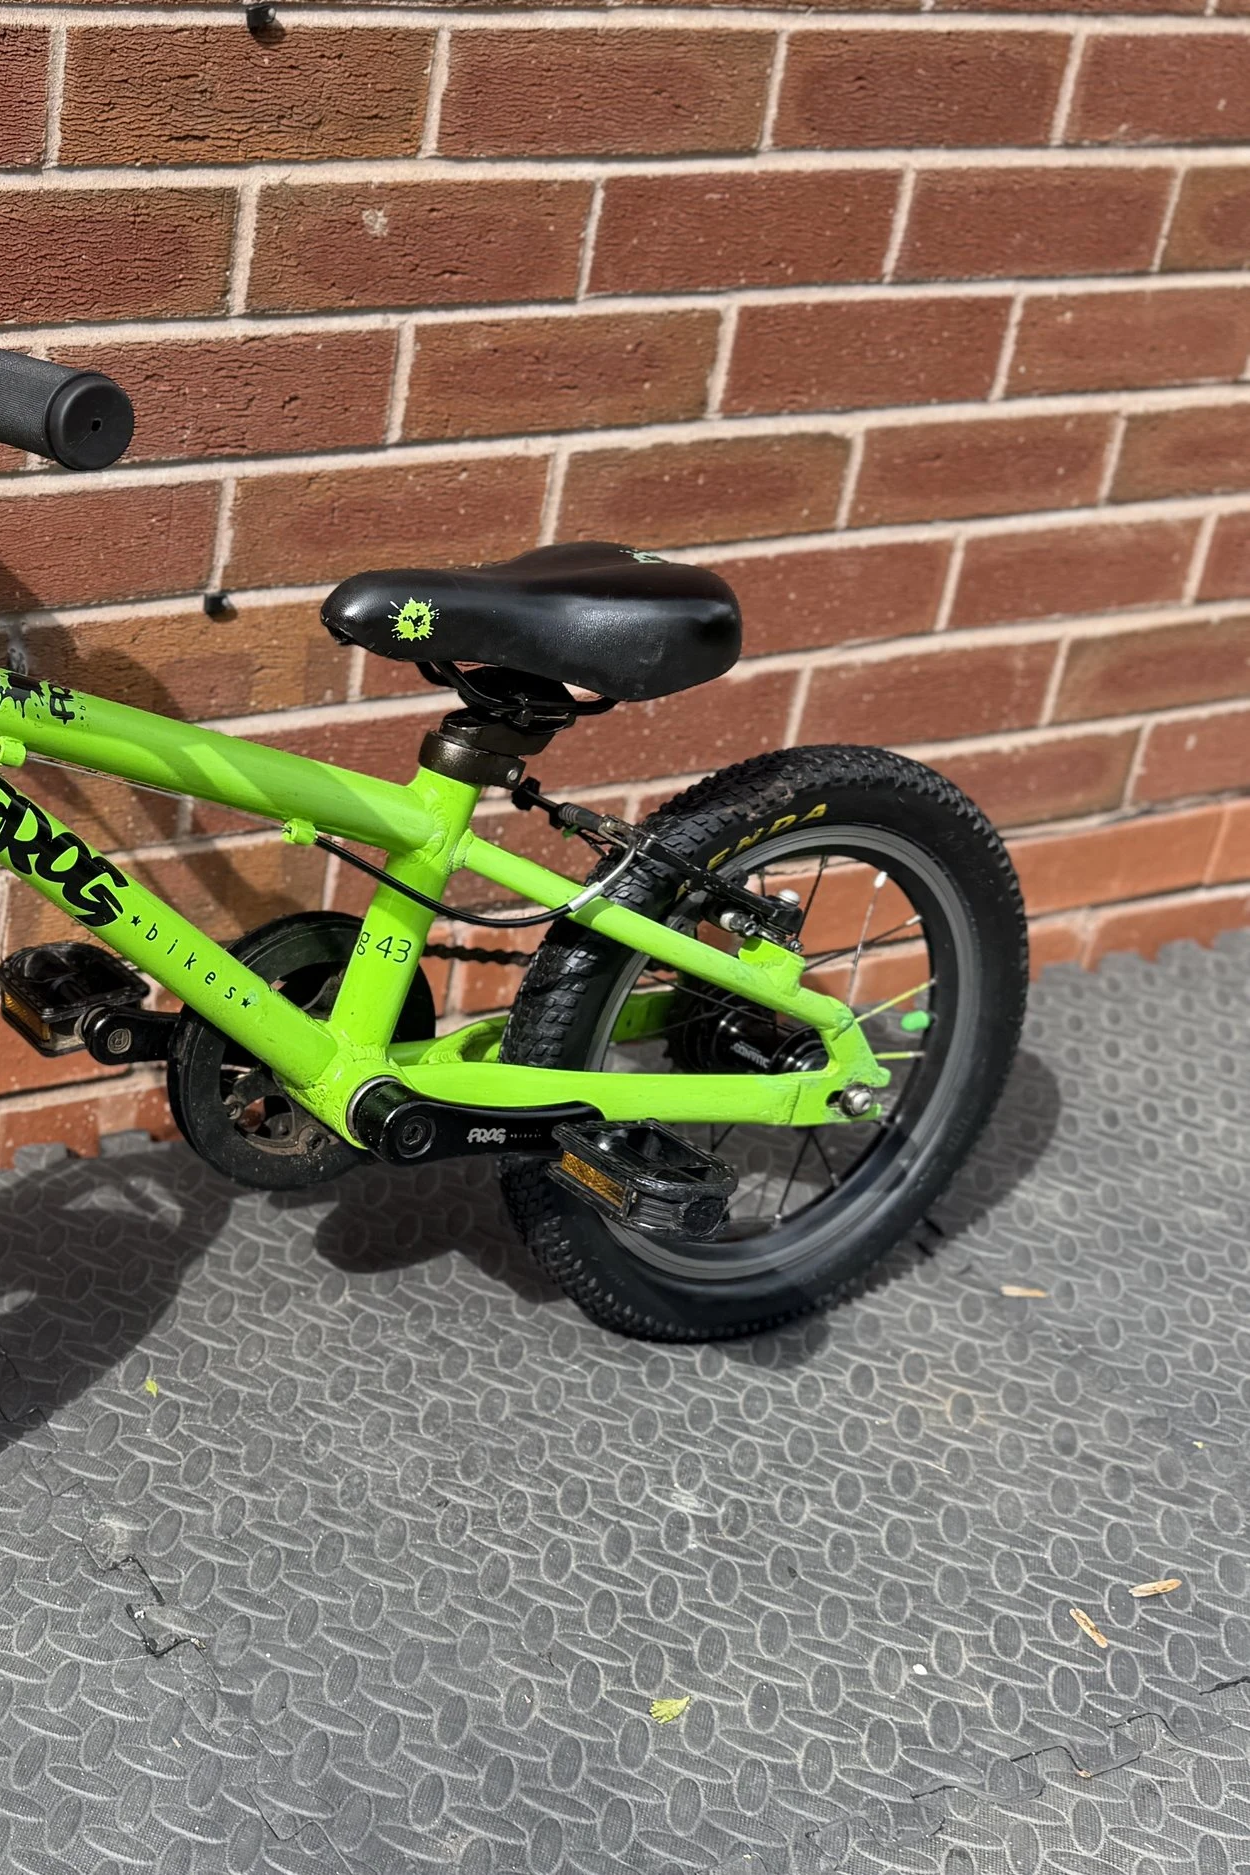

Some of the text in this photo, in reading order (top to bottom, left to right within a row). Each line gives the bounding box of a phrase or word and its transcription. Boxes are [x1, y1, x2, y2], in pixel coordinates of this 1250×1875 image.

[145, 923, 237, 1001] bikes
[376, 935, 412, 963] 43
[466, 1127, 507, 1145] FROG
